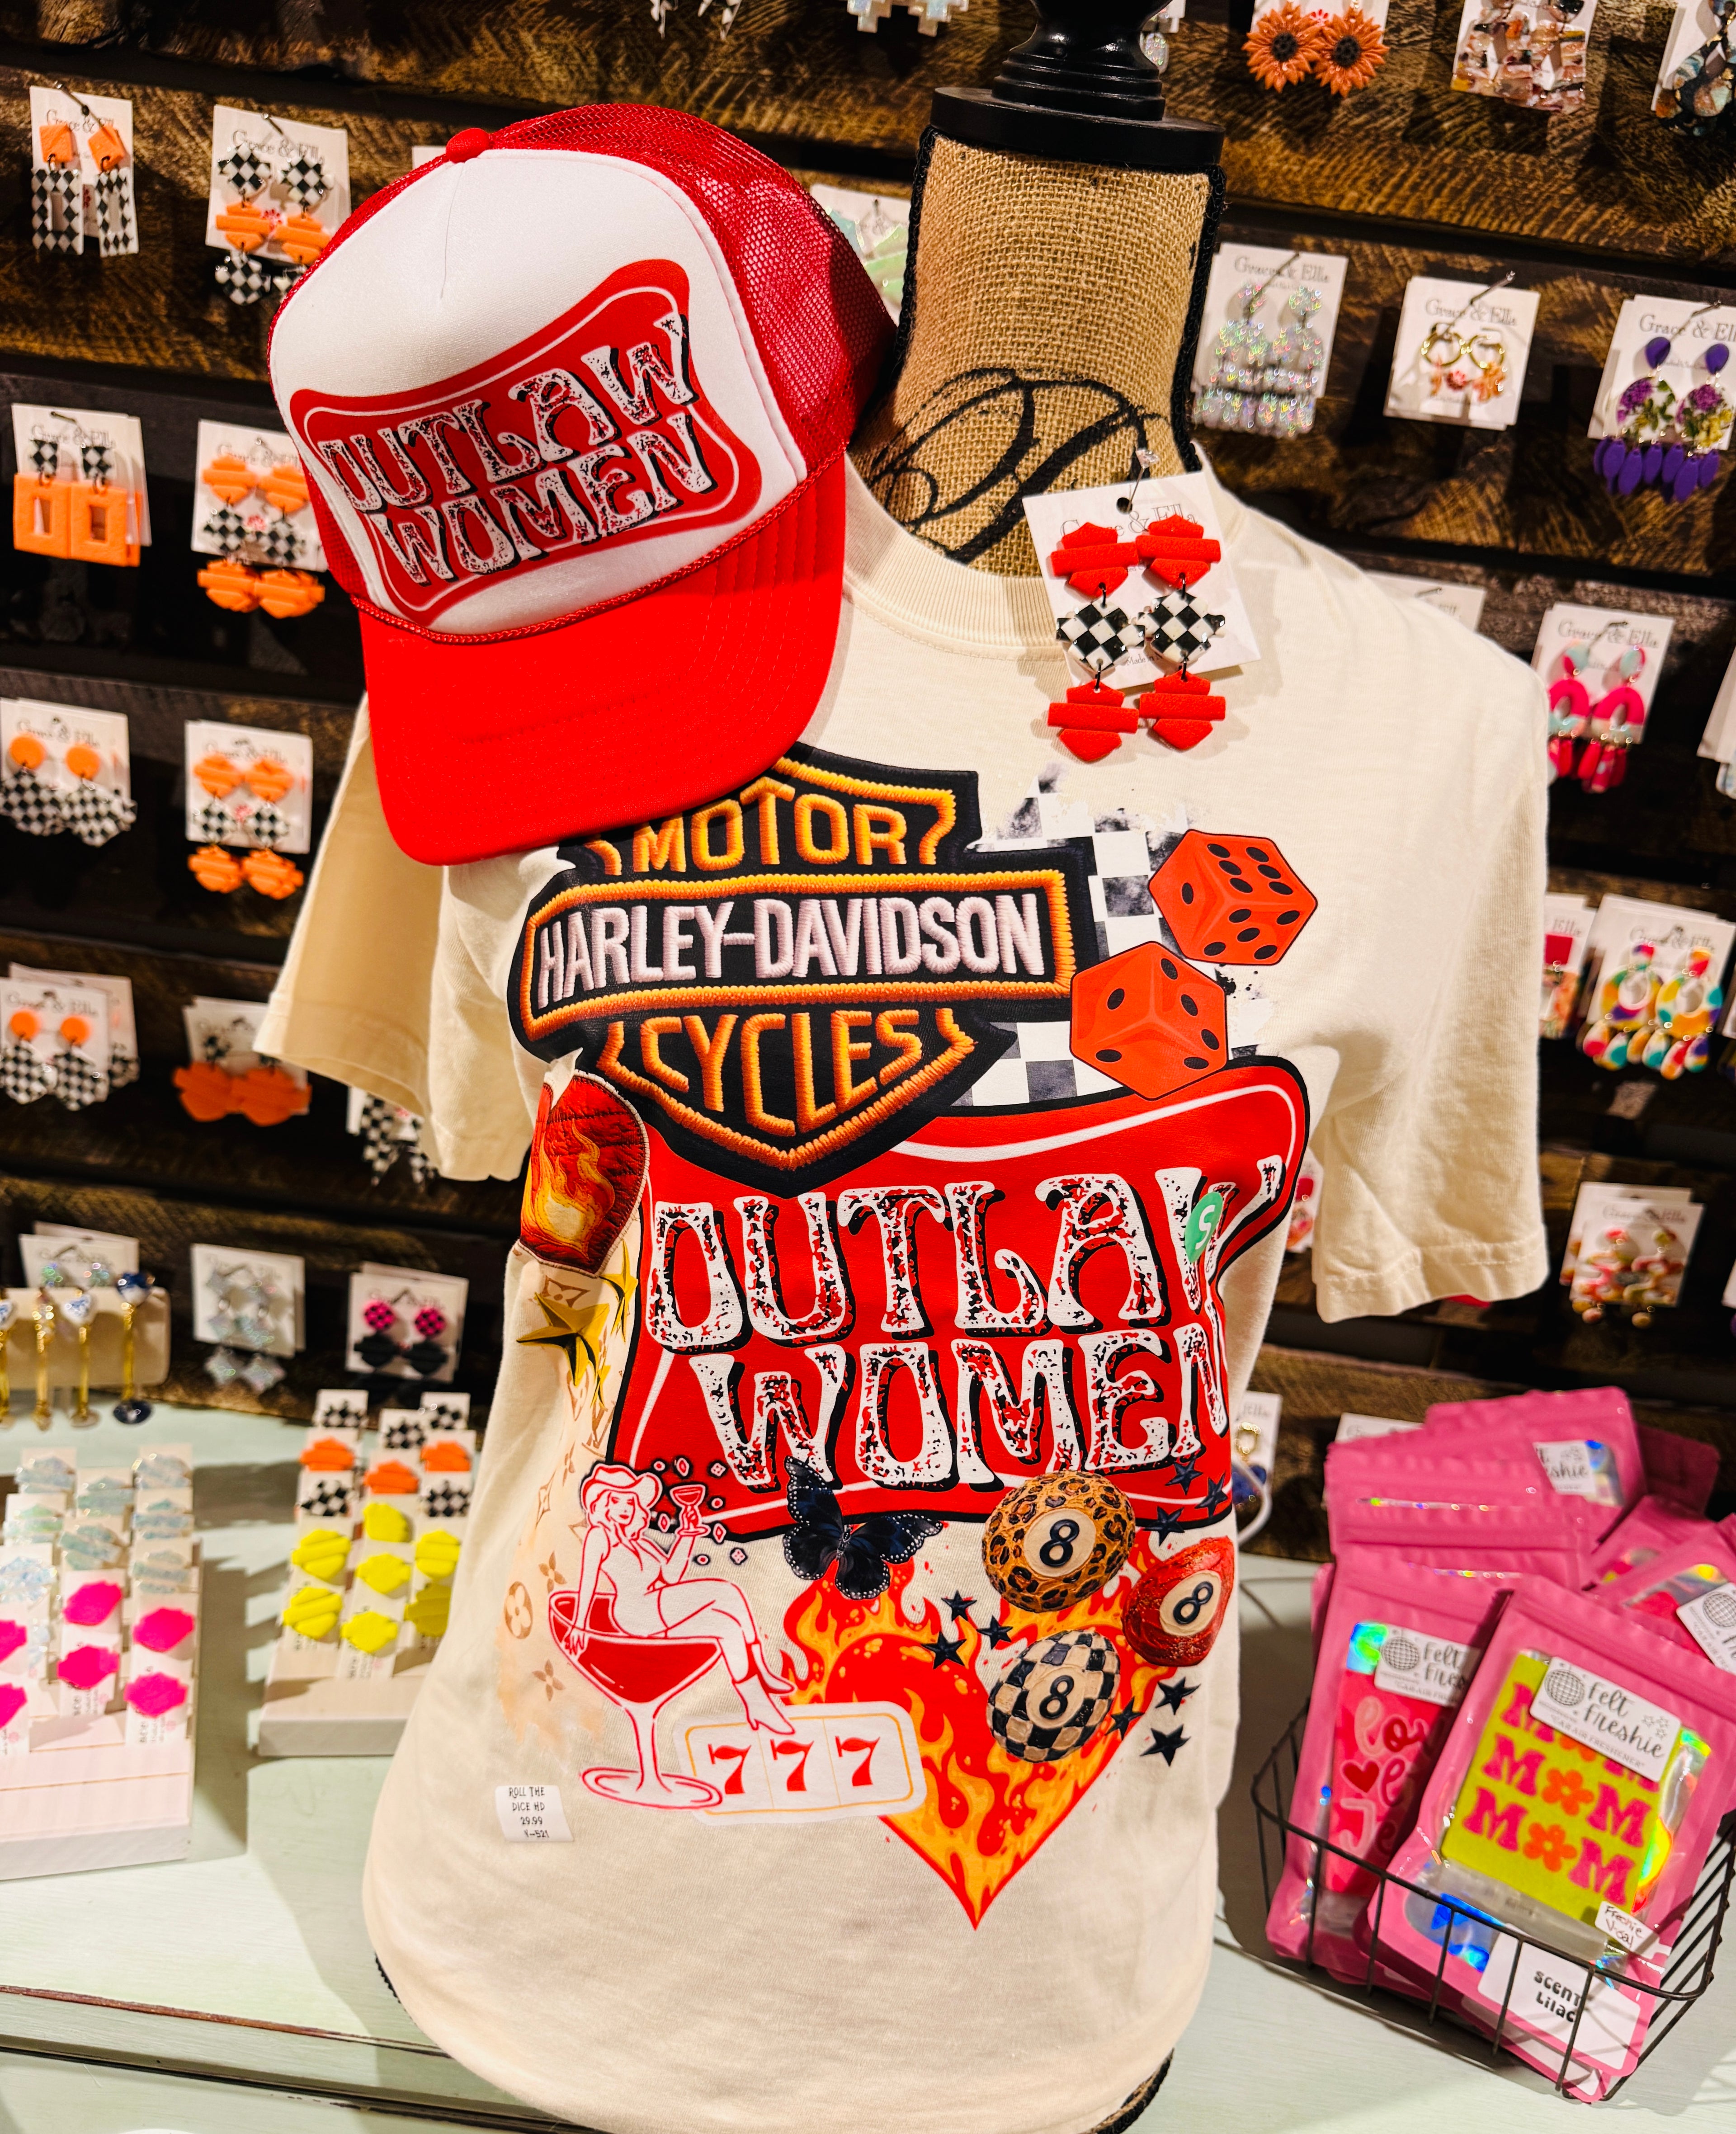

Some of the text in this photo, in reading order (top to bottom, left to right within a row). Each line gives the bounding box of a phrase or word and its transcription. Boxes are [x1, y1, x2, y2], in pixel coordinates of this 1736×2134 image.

[1471, 303, 1486, 321] &
[1693, 318, 1711, 339] &
[317, 312, 699, 514] OUTLAW
[363, 413, 717, 586] WOMEN
[1128, 510, 1149, 533] &
[634, 777, 907, 872] MOTOR
[537, 893, 1045, 1010] HARLEY-DAVIDSON
[640, 1008, 923, 1137] CYCLES
[1195, 1204, 1216, 1250] S
[646, 1154, 1285, 1354] OUTLAW
[689, 1296, 1230, 1492] WOMEN
[1039, 1519, 1080, 1567] 8
[1172, 1581, 1214, 1625] 8
[1424, 1641, 1466, 1669] Felt
[1039, 1674, 1075, 1719] 8
[1588, 1682, 1635, 1717] Felt
[1584, 1703, 1665, 1757] Freshie
[509, 1786, 545, 1798] ROLL THE
[512, 1801, 545, 1811] DICE HD
[520, 1816, 543, 1825] 29.99
